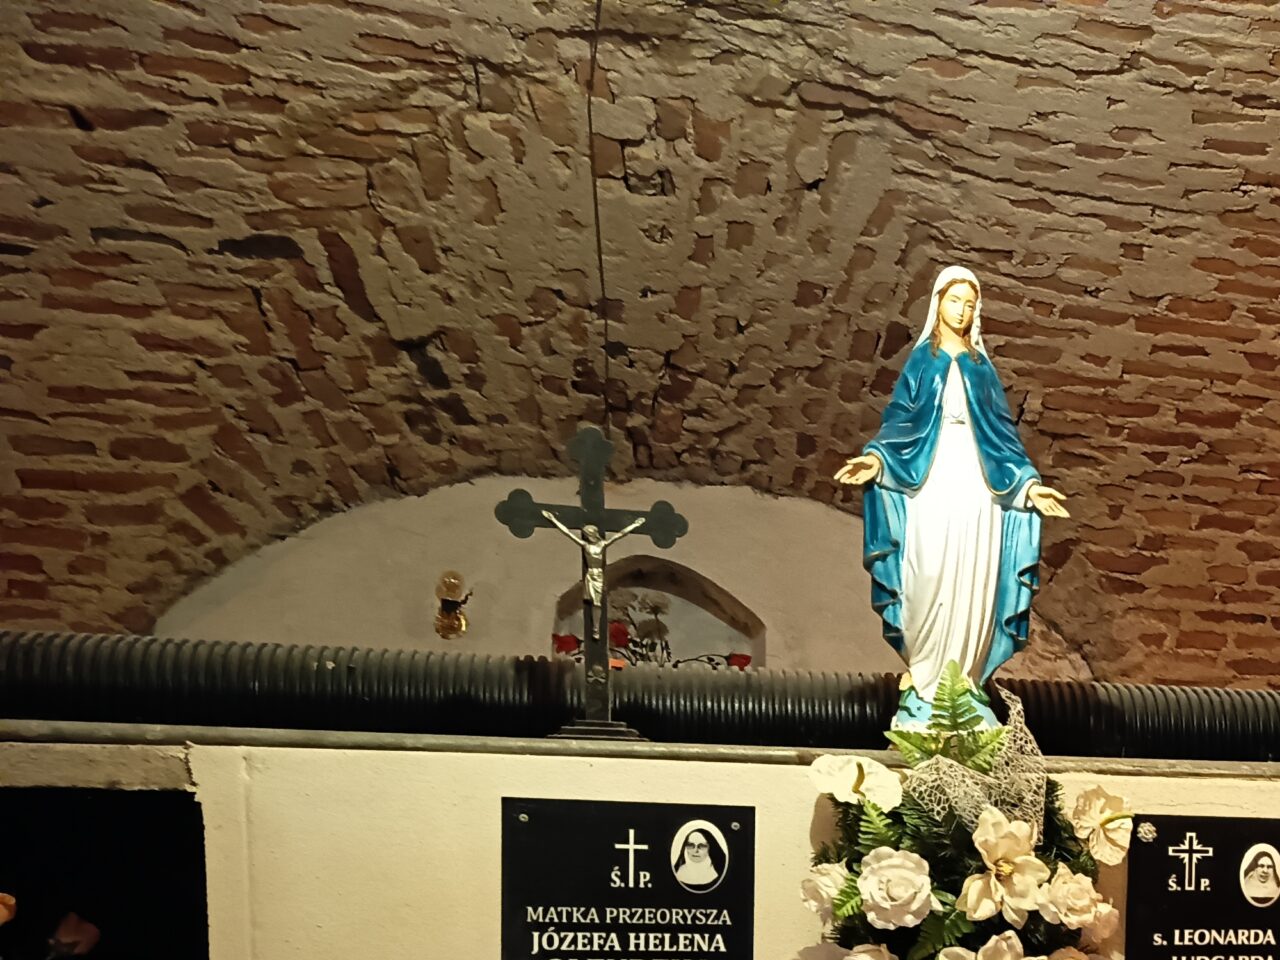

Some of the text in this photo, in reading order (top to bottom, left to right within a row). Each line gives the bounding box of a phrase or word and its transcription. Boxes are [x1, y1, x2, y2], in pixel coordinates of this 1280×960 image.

[639, 871, 652, 888] P.
[1201, 878, 1210, 891] P.
[527, 907, 731, 925] MATKA PRZEORYSZA
[531, 927, 726, 954] JÓZEFA HELENA
[1153, 929, 1276, 945] s. LEONARDA
